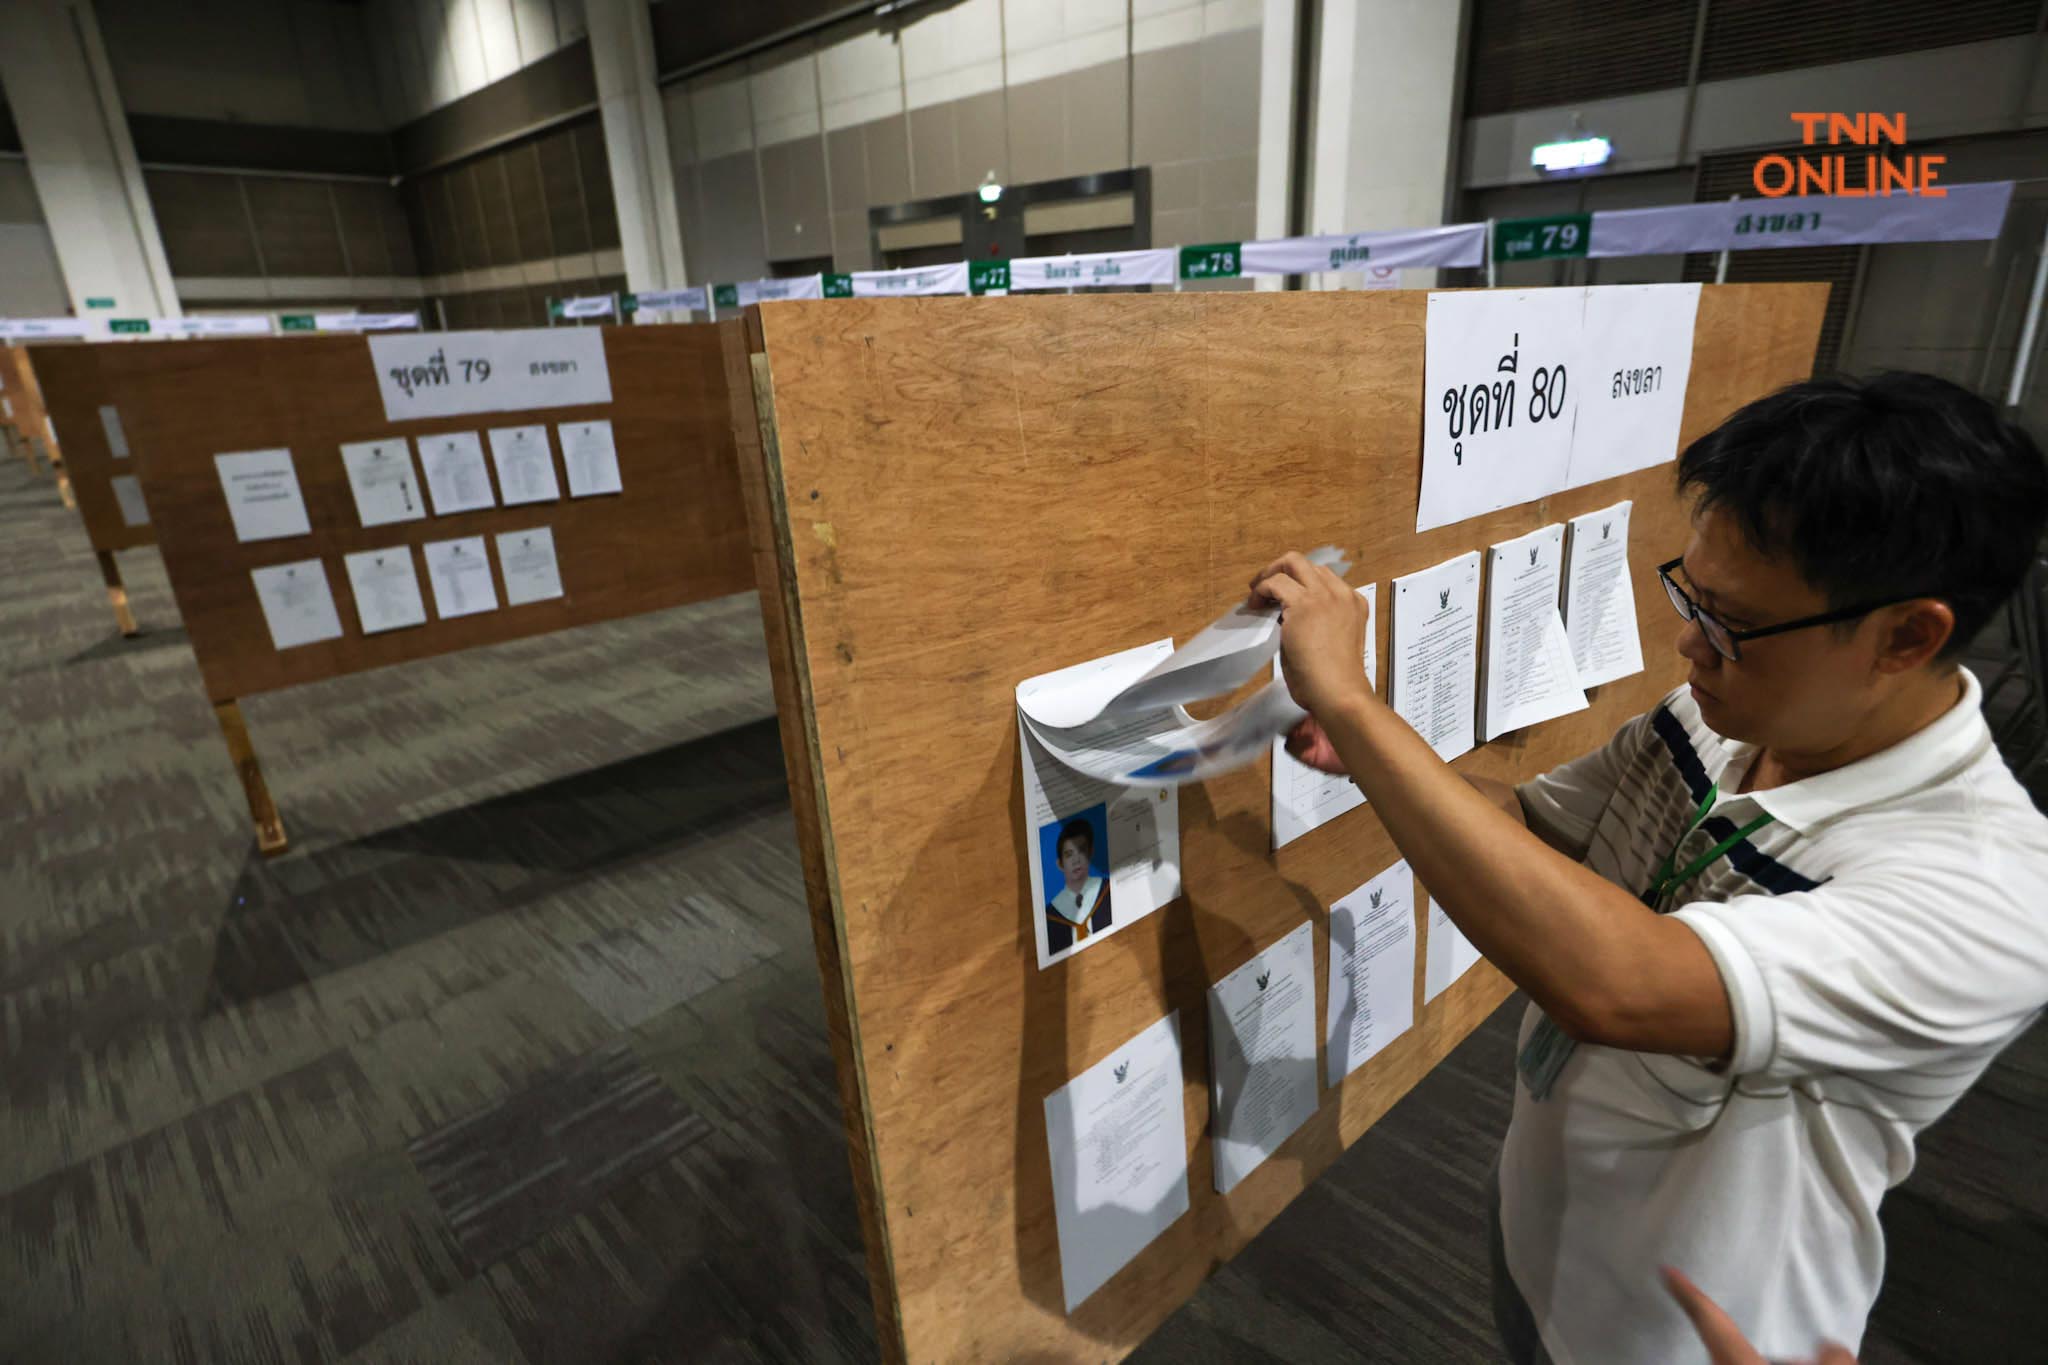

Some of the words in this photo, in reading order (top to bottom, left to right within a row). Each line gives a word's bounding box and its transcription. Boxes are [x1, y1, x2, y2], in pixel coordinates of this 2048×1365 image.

[1541, 223, 1580, 251] 79
[1735, 212, 1821, 235] สงขลา
[1210, 252, 1235, 273] 78
[390, 347, 450, 398] ชุดที่
[457, 358, 491, 384] 79
[1443, 333, 1519, 465] ชุดที่
[1529, 364, 1567, 423] 80
[1612, 366, 1662, 399] สงขลา
